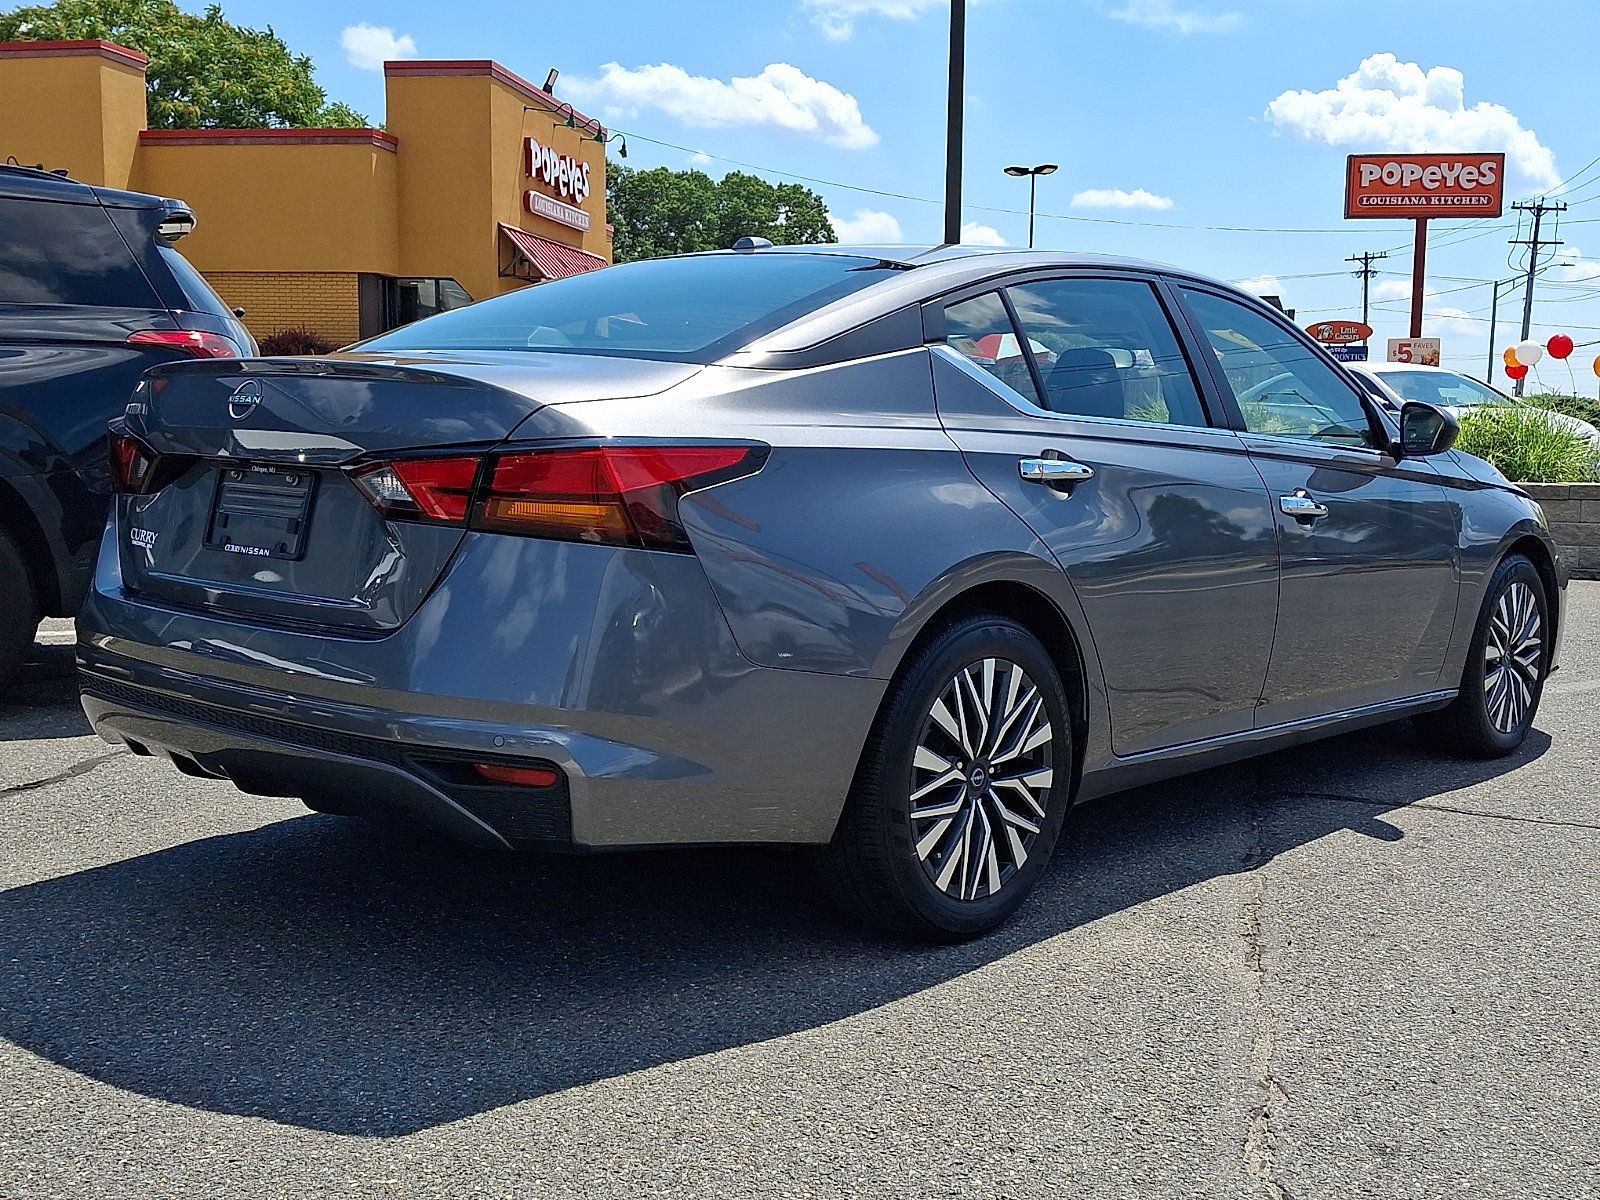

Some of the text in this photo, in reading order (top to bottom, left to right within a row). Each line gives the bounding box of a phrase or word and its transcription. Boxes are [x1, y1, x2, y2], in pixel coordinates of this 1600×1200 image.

[1362, 196, 1488, 205] LOUISIANA KITCHEN
[1340, 326, 1358, 334] Little
[229, 395, 260, 404] NISSAN
[131, 527, 158, 544] CURRY
